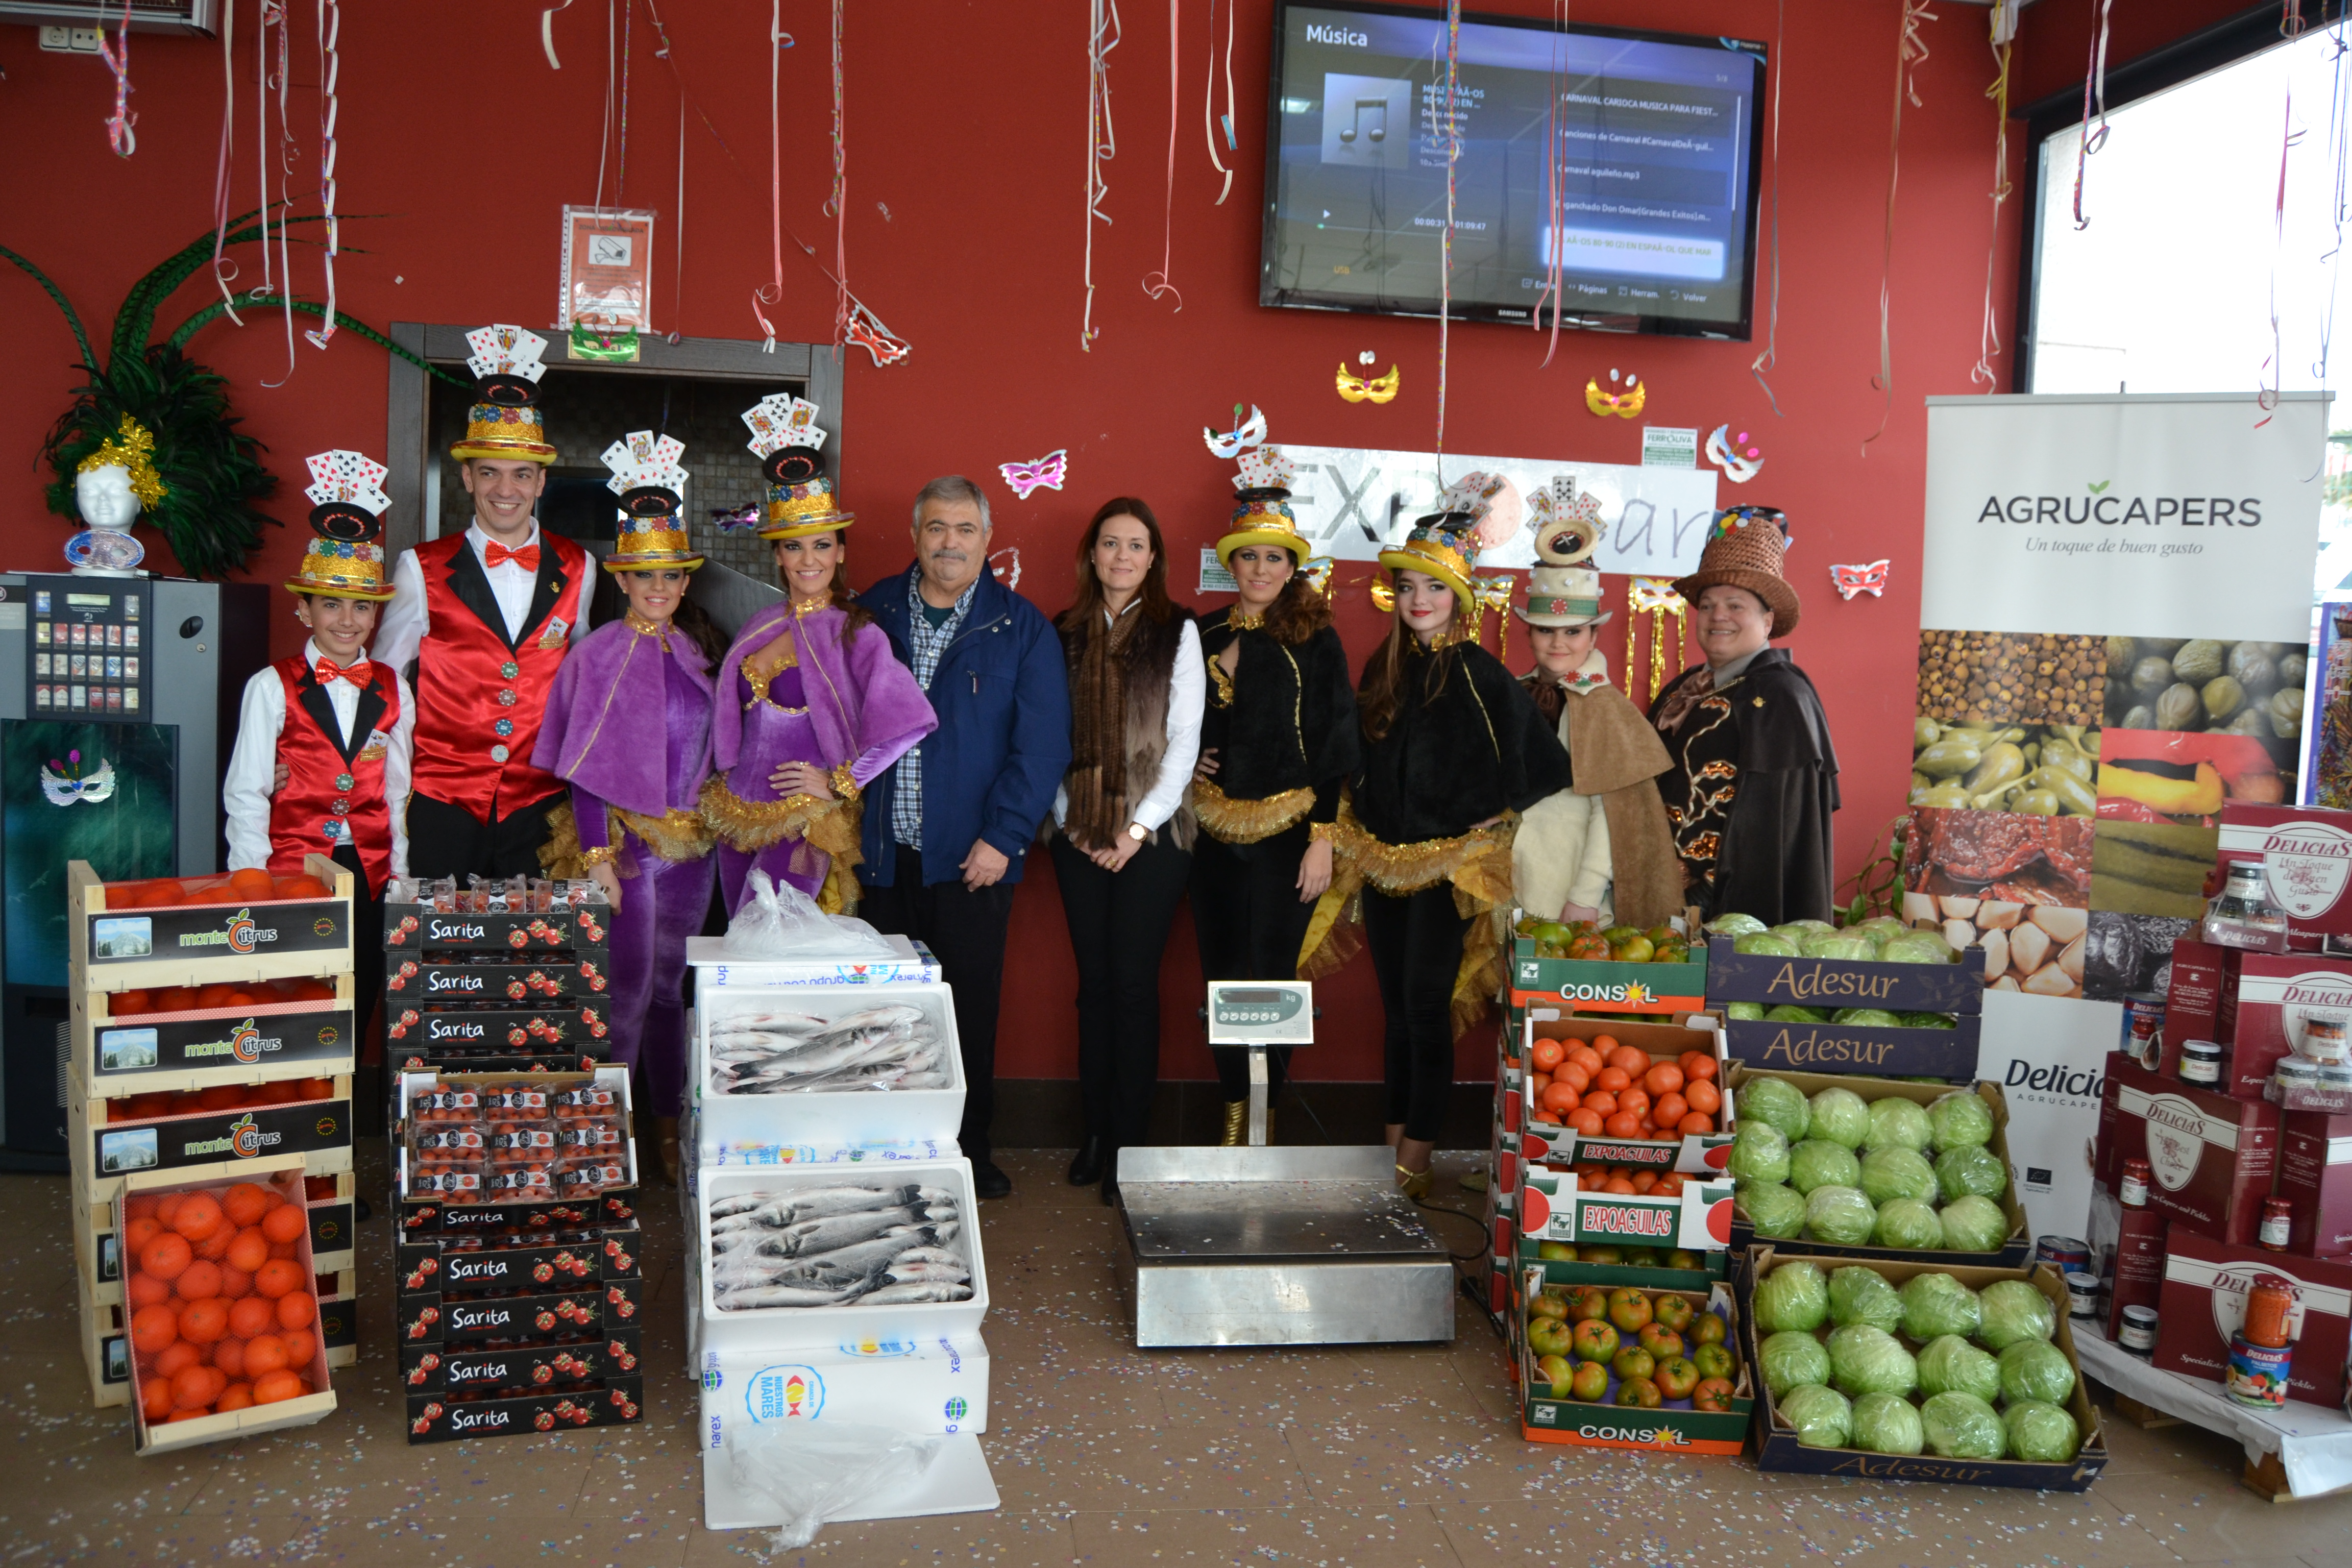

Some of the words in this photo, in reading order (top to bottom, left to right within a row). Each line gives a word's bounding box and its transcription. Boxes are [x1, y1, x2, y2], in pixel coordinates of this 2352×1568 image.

[1306, 24, 1368, 47] Música
[1603, 96, 1638, 108] CARIOCA
[1639, 100, 1669, 111] MUSICA
[1670, 104, 1690, 113] PARA
[1598, 132, 1607, 140] de
[1609, 134, 1641, 144] Carnaval
[1602, 204, 1617, 213] Don
[1414, 217, 1446, 227] 00:00:31
[1455, 221, 1486, 231] 01:09:47
[1678, 246, 1694, 255] QUE
[1696, 248, 1711, 256] MAR
[1334, 265, 1350, 275] USB
[1578, 283, 1607, 296] Páginas
[1631, 289, 1660, 299] Herram.
[1683, 292, 1707, 302] Volver
[1498, 309, 1527, 318] SAMSUNG
[1977, 495, 2262, 527] AGRUCAPERS
[2025, 536, 2047, 552] Un
[2051, 538, 2093, 556] toque
[2097, 537, 2116, 553] de
[2119, 537, 2157, 554] buen
[2160, 541, 2203, 558] gusto
[2263, 835, 2352, 857] DELICIAS
[2297, 858, 2334, 871] Toque
[430, 919, 485, 939] Sarita
[429, 971, 483, 991] Sarita
[1767, 962, 1899, 999] Adesur
[430, 1019, 484, 1039] Sarita
[1762, 1028, 1894, 1066] Adesur
[2146, 1102, 2206, 1136] DELICIAS
[1582, 1144, 1672, 1163] EXPOAGUILAS
[447, 1211, 504, 1224] Sarita
[2159, 1195, 2178, 1209] Capers
[2178, 1206, 2190, 1214] and
[2190, 1209, 2211, 1222] Pickles
[1584, 1205, 1672, 1237] EXPOAGUILAS
[450, 1259, 508, 1279] Sarita
[452, 1308, 510, 1329] Sarita
[2246, 1349, 2284, 1362] DELICIAS
[2251, 1360, 2278, 1368] PALMITOS
[450, 1361, 508, 1382] Sarita
[760, 1376, 774, 1418] MARES
[774, 1375, 783, 1418] NUESTROS
[452, 1409, 510, 1430] Sarita
[1831, 1456, 1991, 1481] Adesur
